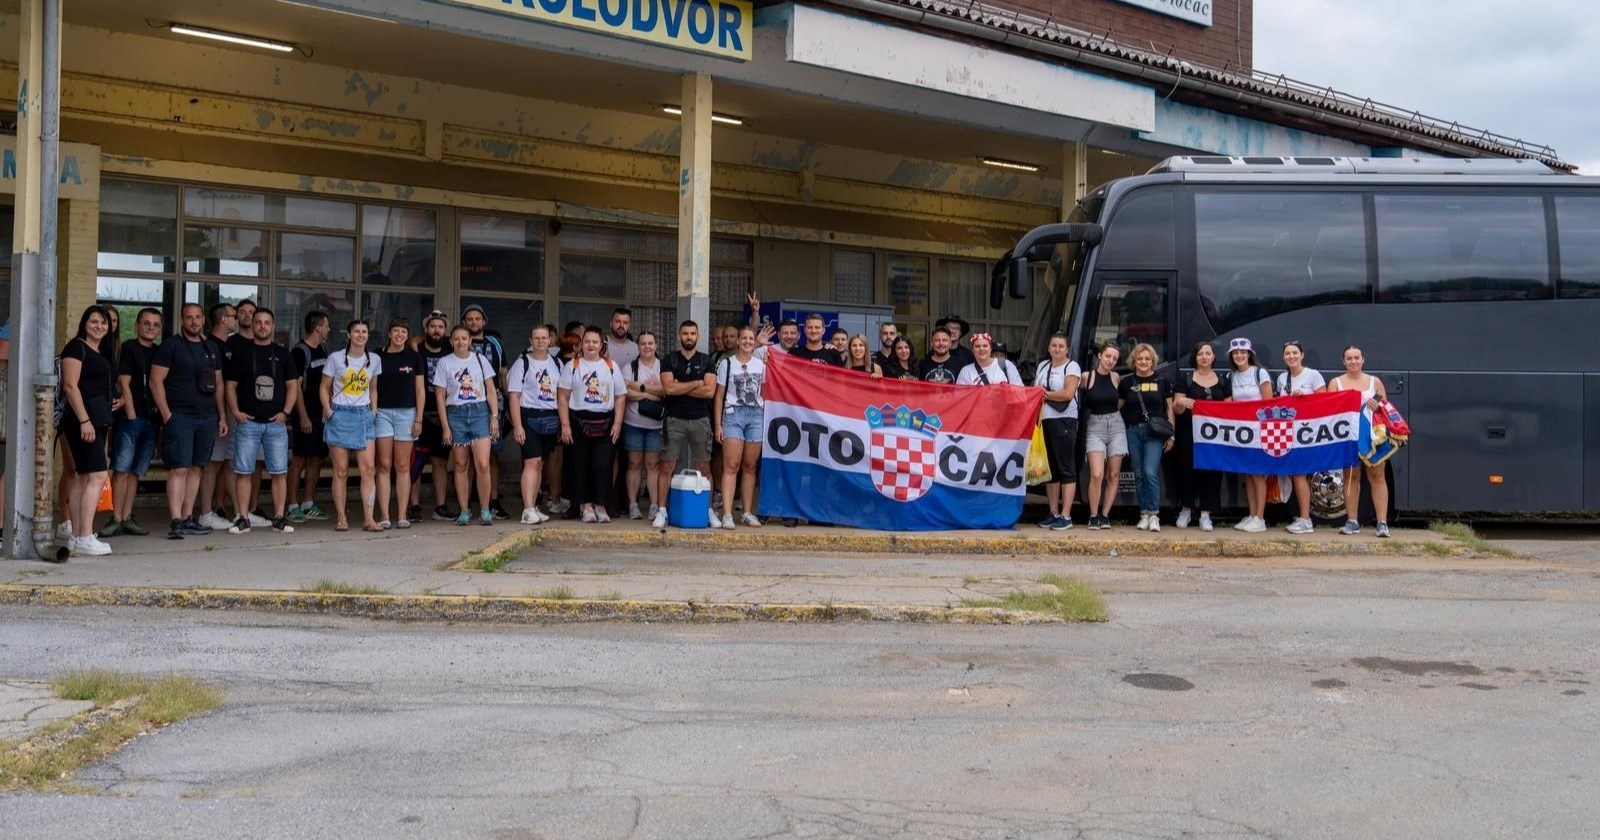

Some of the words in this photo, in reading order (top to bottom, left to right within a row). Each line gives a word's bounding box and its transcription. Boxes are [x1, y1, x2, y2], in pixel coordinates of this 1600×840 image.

[501, 0, 743, 51] LODVOR
[767, 416, 865, 466] OTO
[938, 434, 1026, 490] ČAC
[1200, 422, 1254, 445] OTO
[1296, 420, 1350, 445] ČAC
